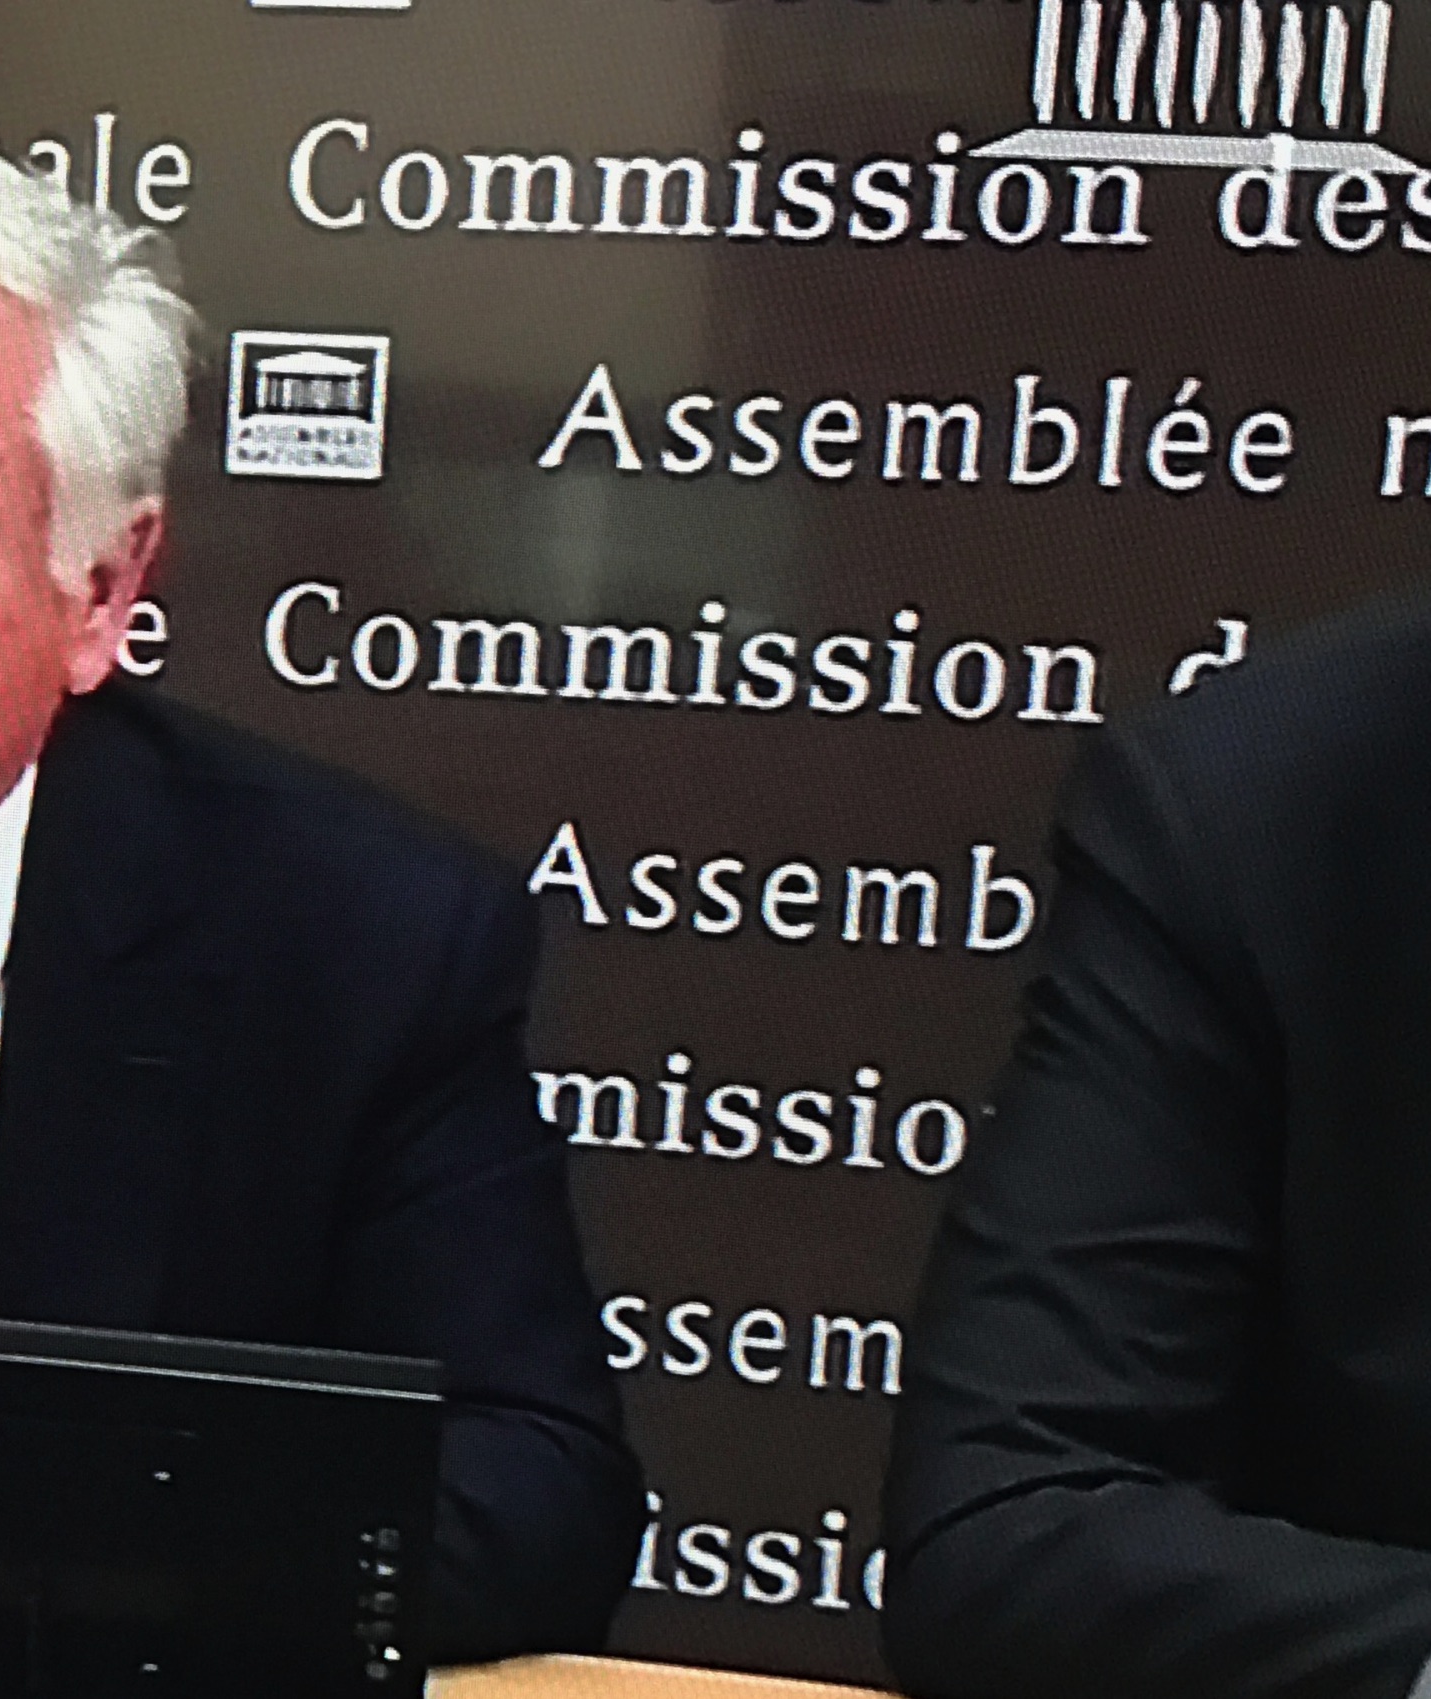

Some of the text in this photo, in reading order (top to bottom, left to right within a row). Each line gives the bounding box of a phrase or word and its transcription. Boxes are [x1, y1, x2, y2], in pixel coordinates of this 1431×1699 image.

[289, 116, 1151, 246] Commission
[1216, 132, 1431, 253] des
[537, 363, 1293, 492] Assemblée
[265, 581, 1104, 724] Commission
[529, 822, 1035, 950] Assemb
[601, 1295, 902, 1395] ssem
